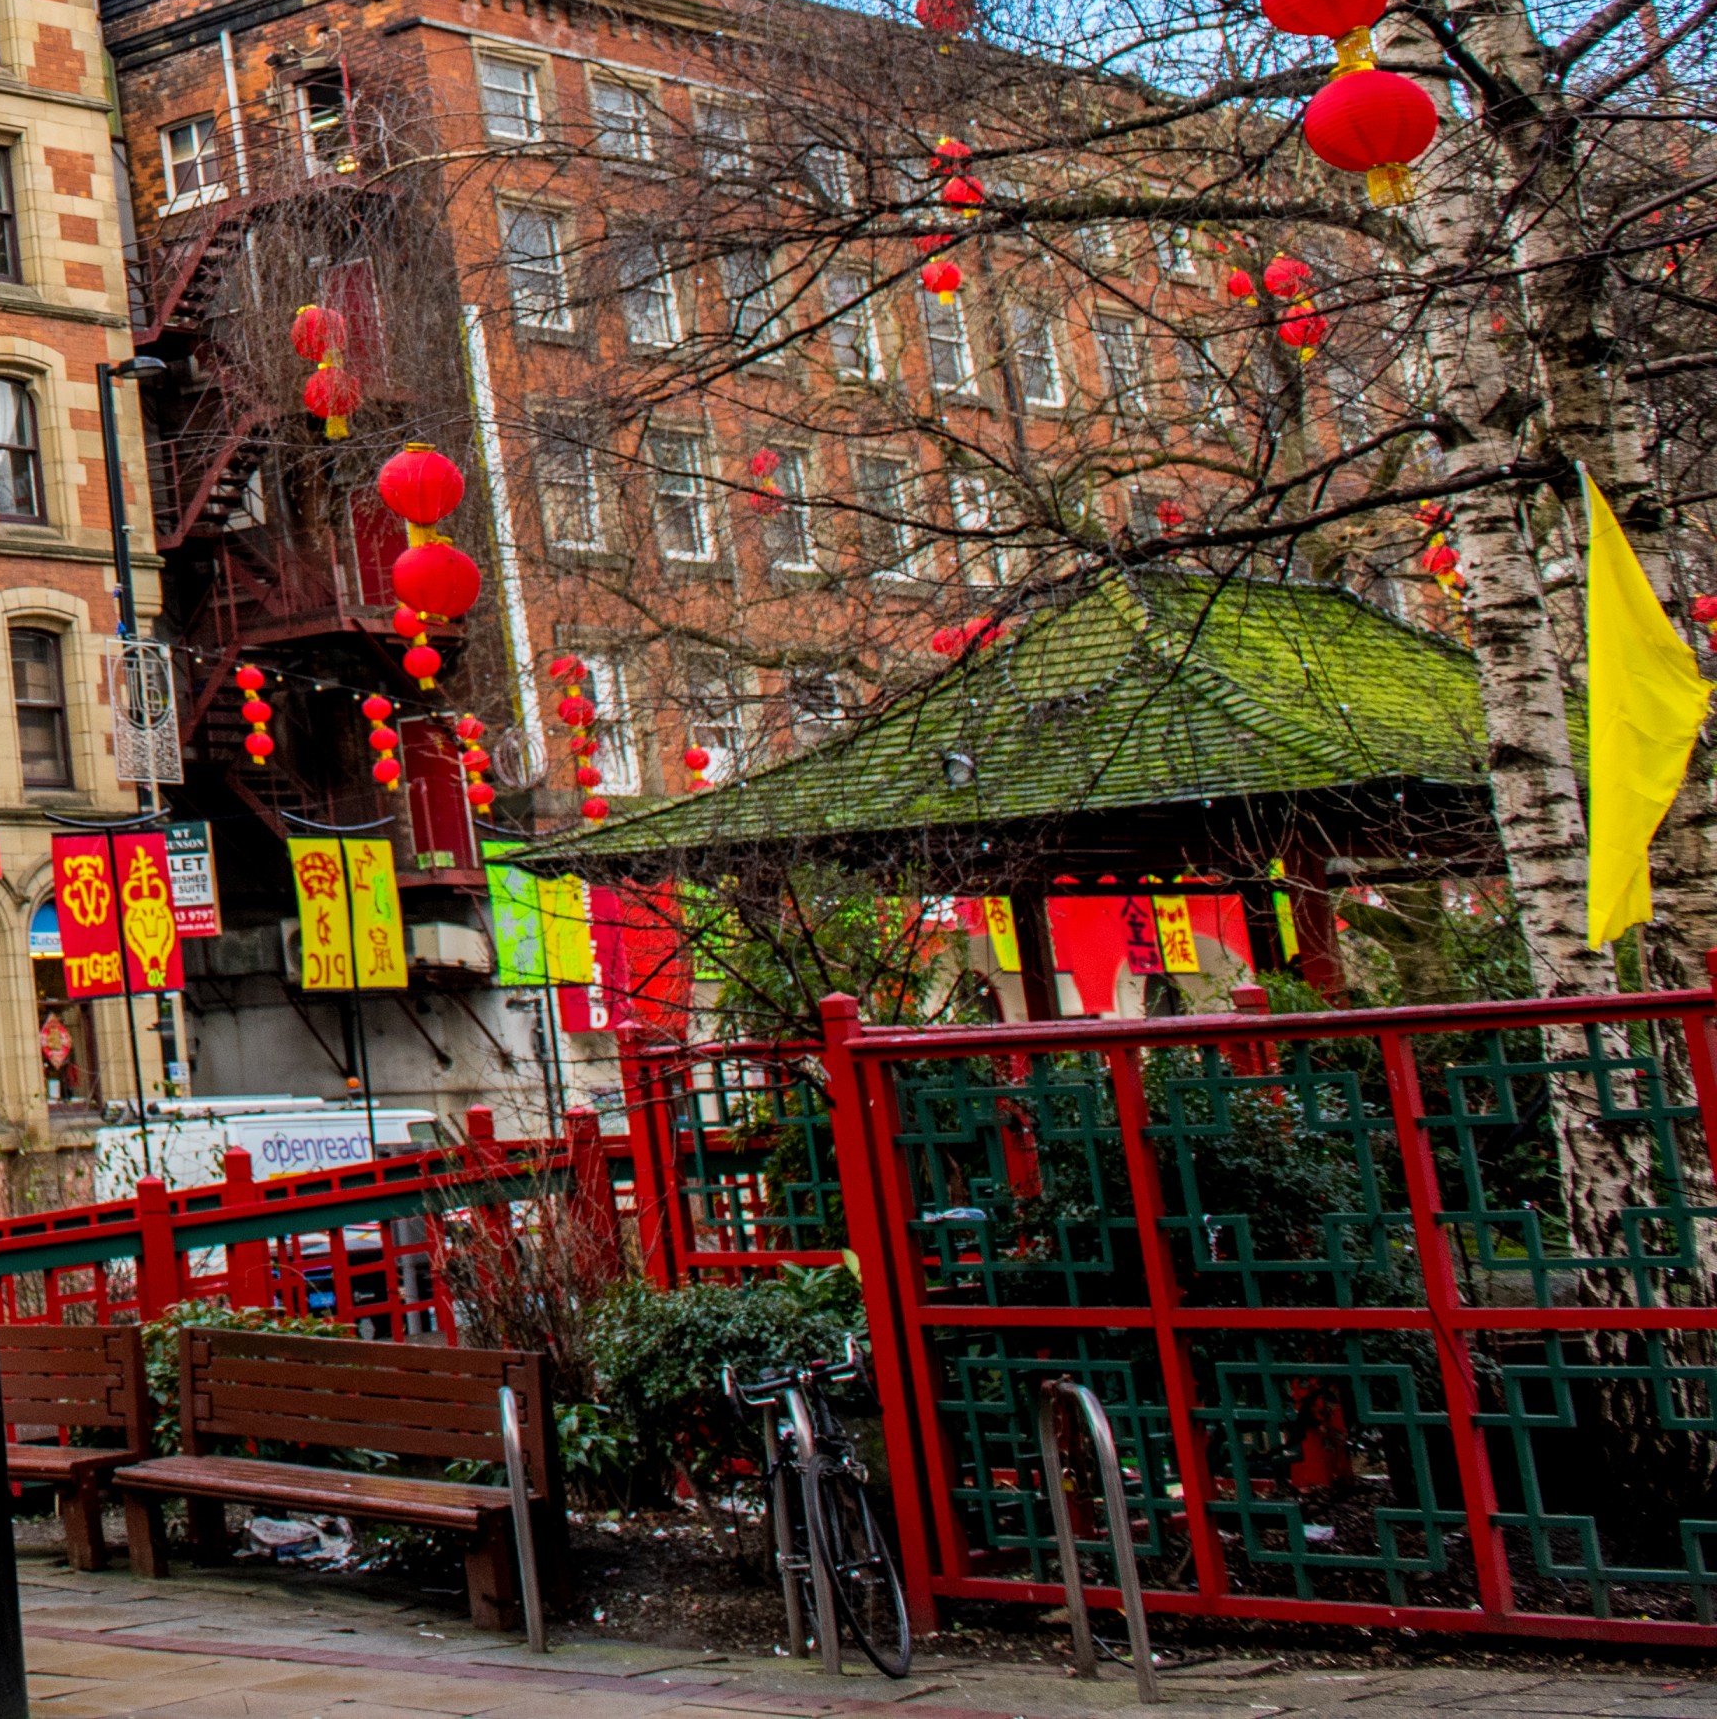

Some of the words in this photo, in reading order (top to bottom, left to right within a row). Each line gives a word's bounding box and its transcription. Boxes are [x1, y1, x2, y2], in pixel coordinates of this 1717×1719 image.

[172, 829, 190, 839] WT
[171, 857, 205, 872] LET
[178, 883, 208, 893] SUITE
[66, 950, 121, 988] TIGER
[147, 969, 166, 987] OX
[262, 1132, 371, 1168] openreach
